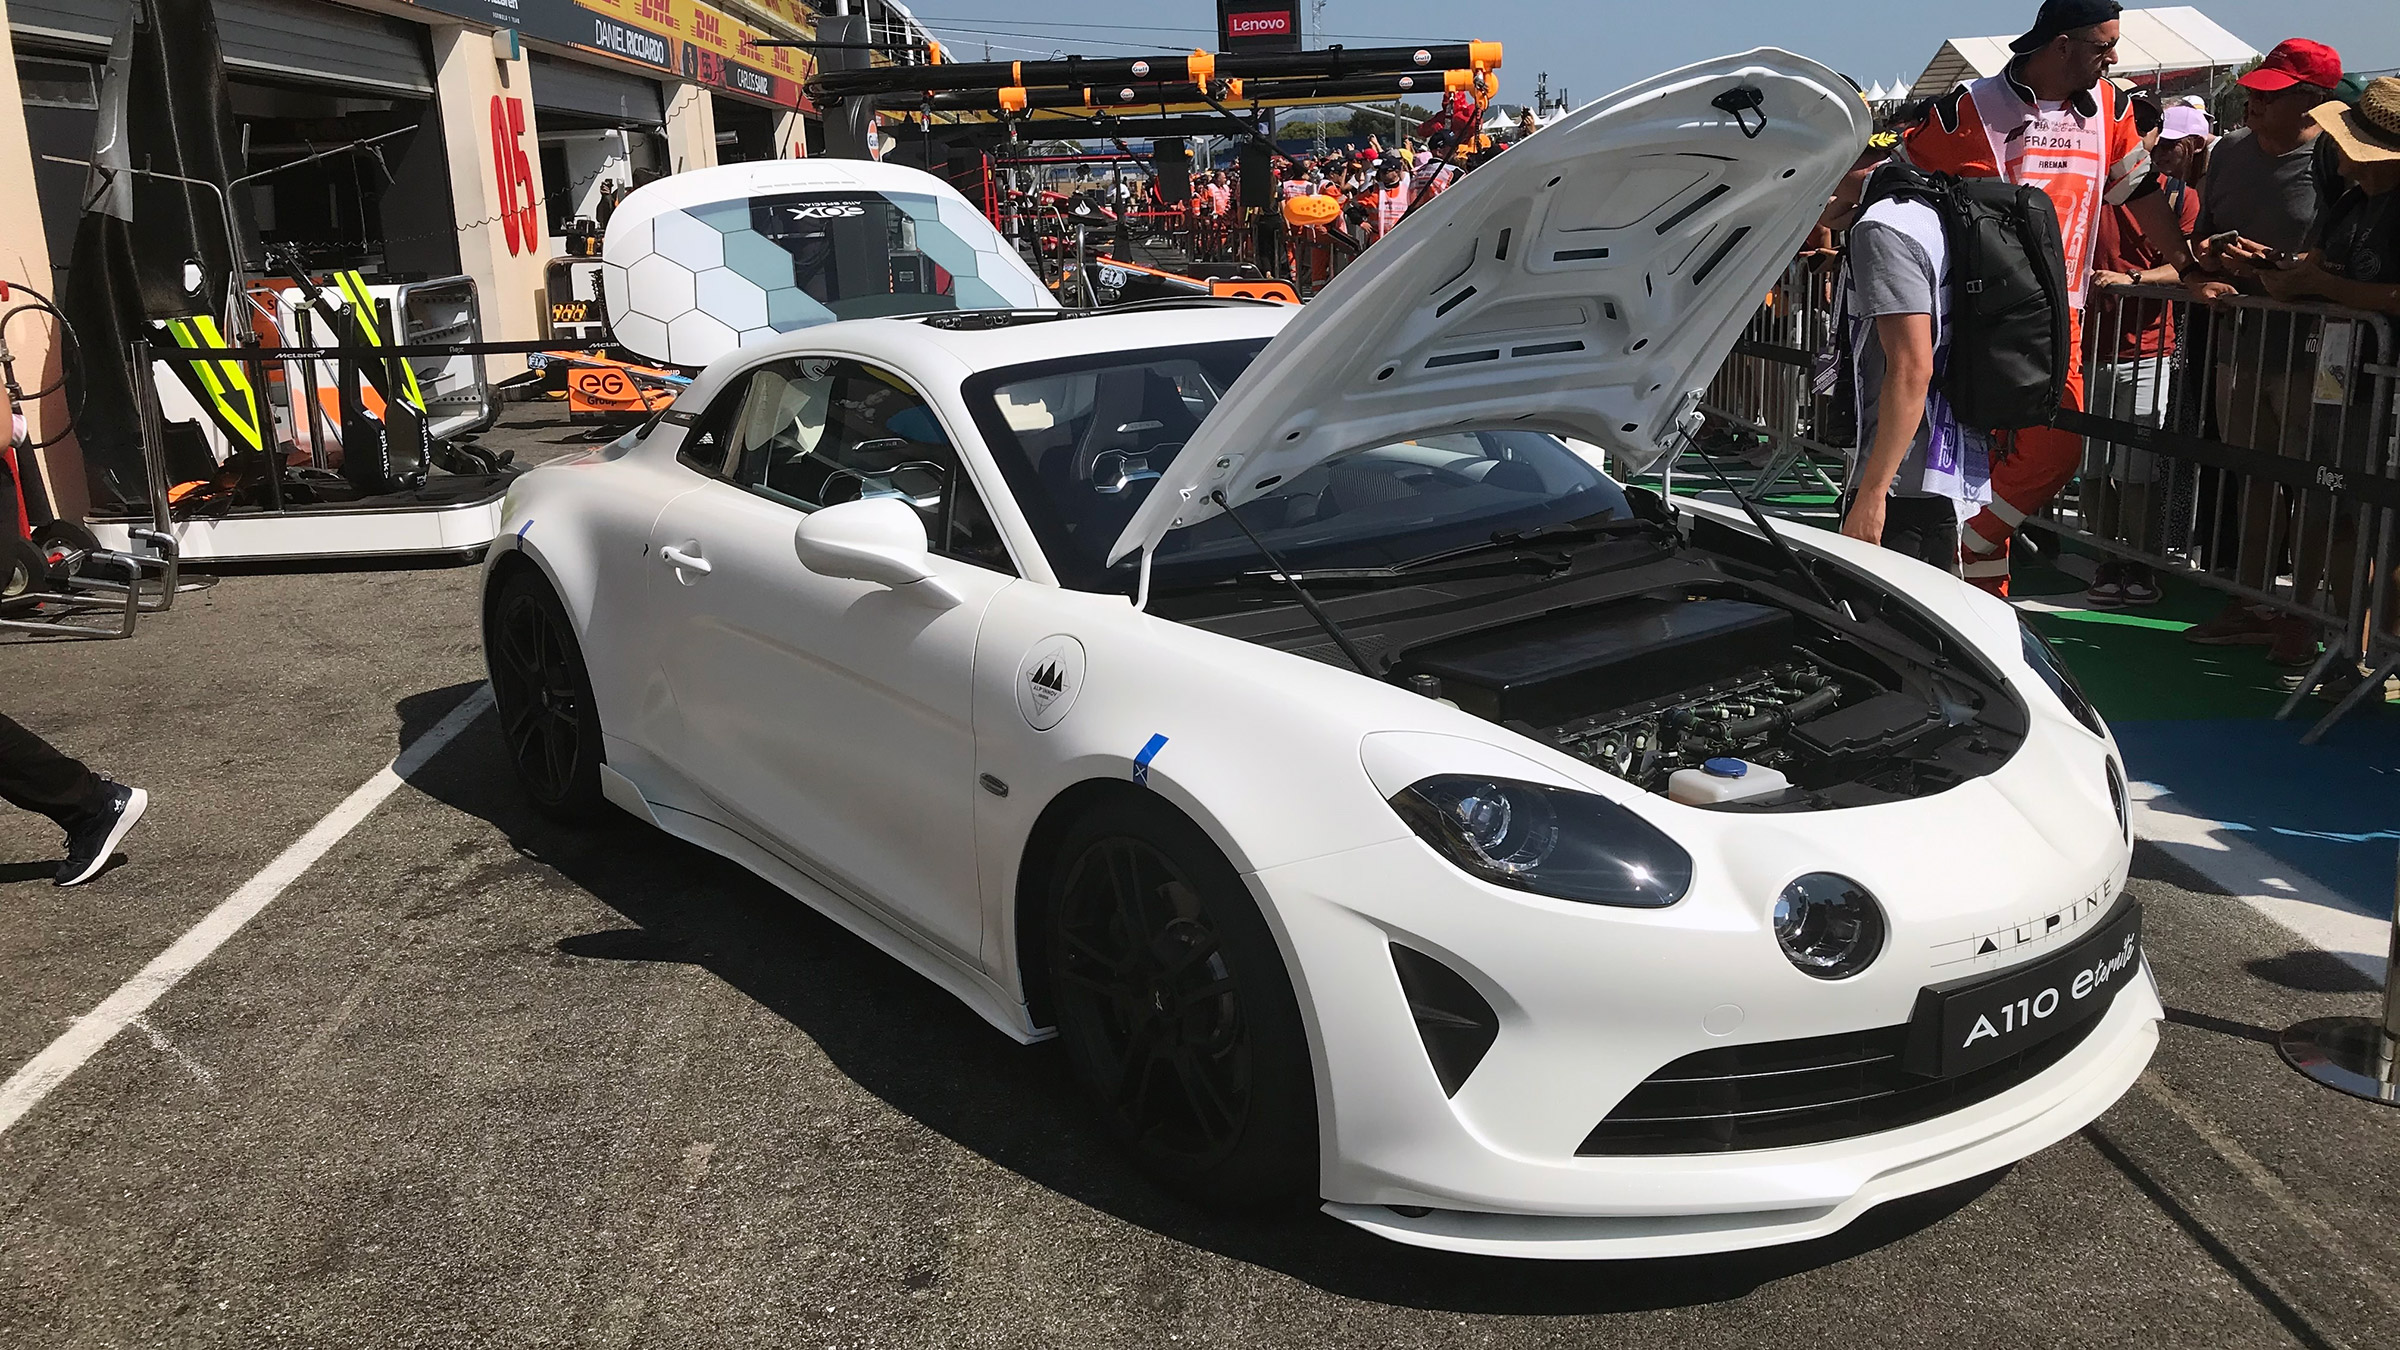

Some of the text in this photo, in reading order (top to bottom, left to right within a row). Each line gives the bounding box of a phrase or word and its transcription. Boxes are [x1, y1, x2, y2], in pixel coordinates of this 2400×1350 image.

[690, 7, 728, 49] DHL
[1233, 18, 1285, 32] Lenovo
[595, 19, 664, 64] DANIEL RICCIARDO
[735, 28, 765, 64] DHL
[771, 47, 795, 75] DHL
[737, 68, 756, 91] CARLOS
[2024, 136, 2081, 149] FRA 204 1
[490, 95, 538, 258] 05
[2038, 161, 2068, 169] FIREMAN
[2067, 179, 2095, 259] FRANCE
[1100, 270, 1126, 288] FIA
[274, 350, 321, 359] McLaren
[529, 355, 548, 369] FIA
[587, 395, 618, 407] Group
[1976, 878, 2112, 955] ALPINE
[1962, 987, 2060, 1049] A110
